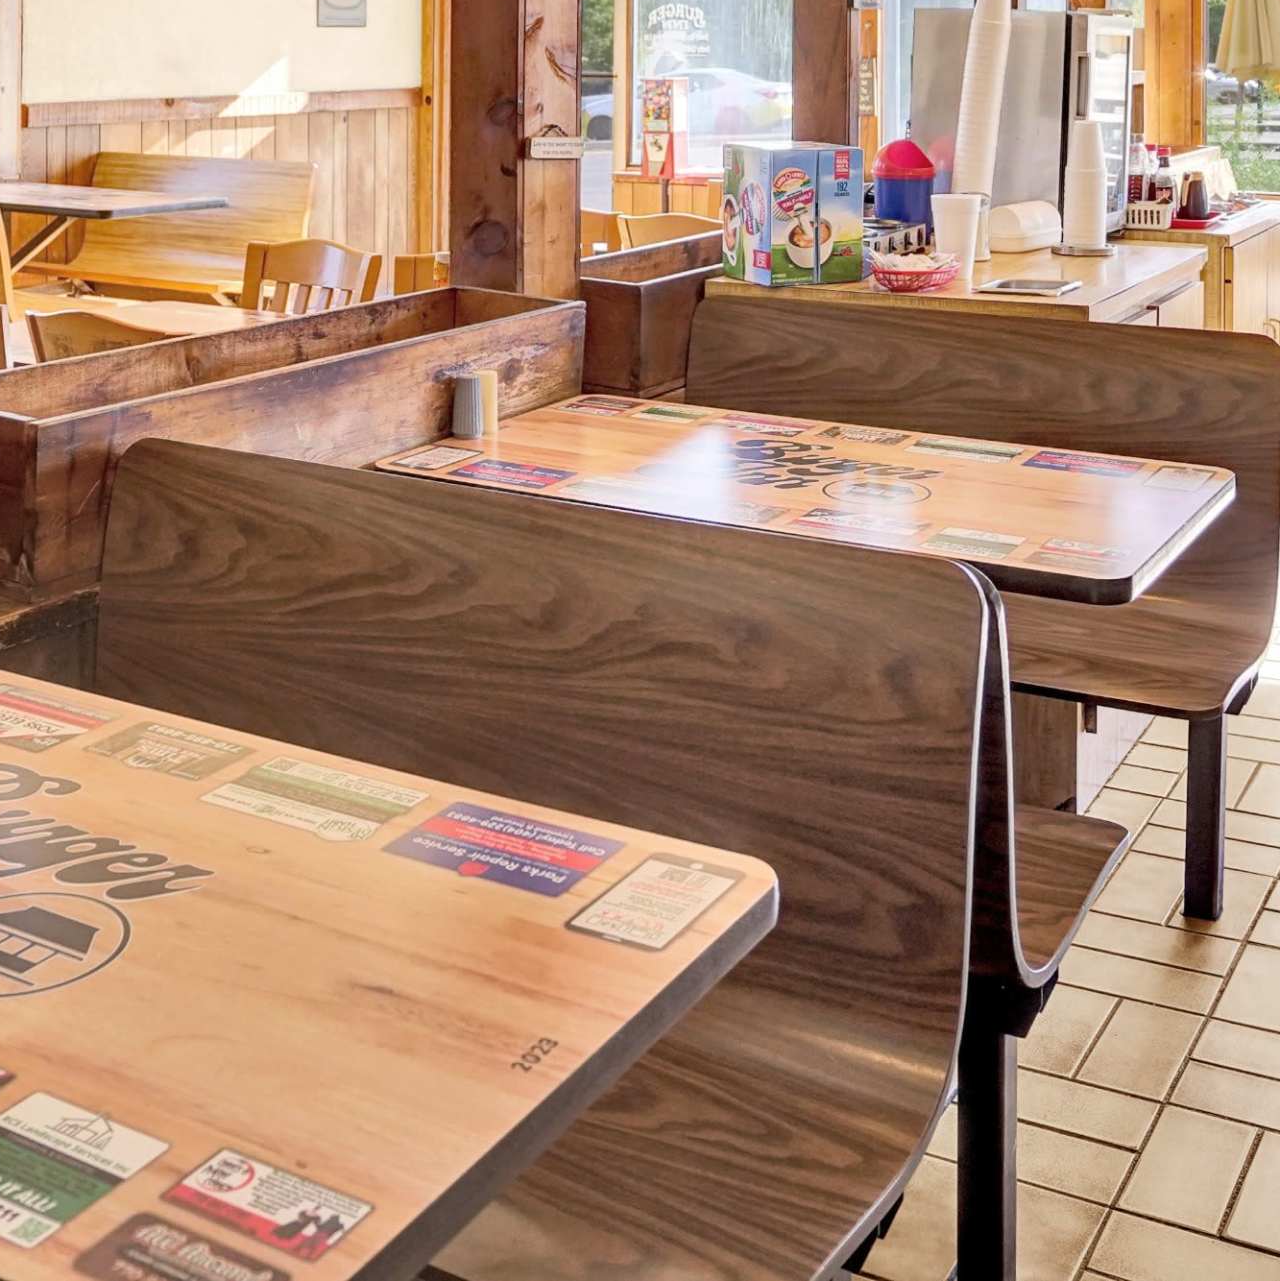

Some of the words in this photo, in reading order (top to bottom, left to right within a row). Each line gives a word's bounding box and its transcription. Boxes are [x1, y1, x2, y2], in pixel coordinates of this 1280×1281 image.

[836, 181, 848, 192] 192
[730, 438, 945, 480] Burger
[407, 835, 470, 858] Service
[464, 849, 523, 872] Repair
[515, 864, 568, 884] Parks
[510, 1036, 559, 1074] 2023
[8, 1186, 61, 1215] ALL!
